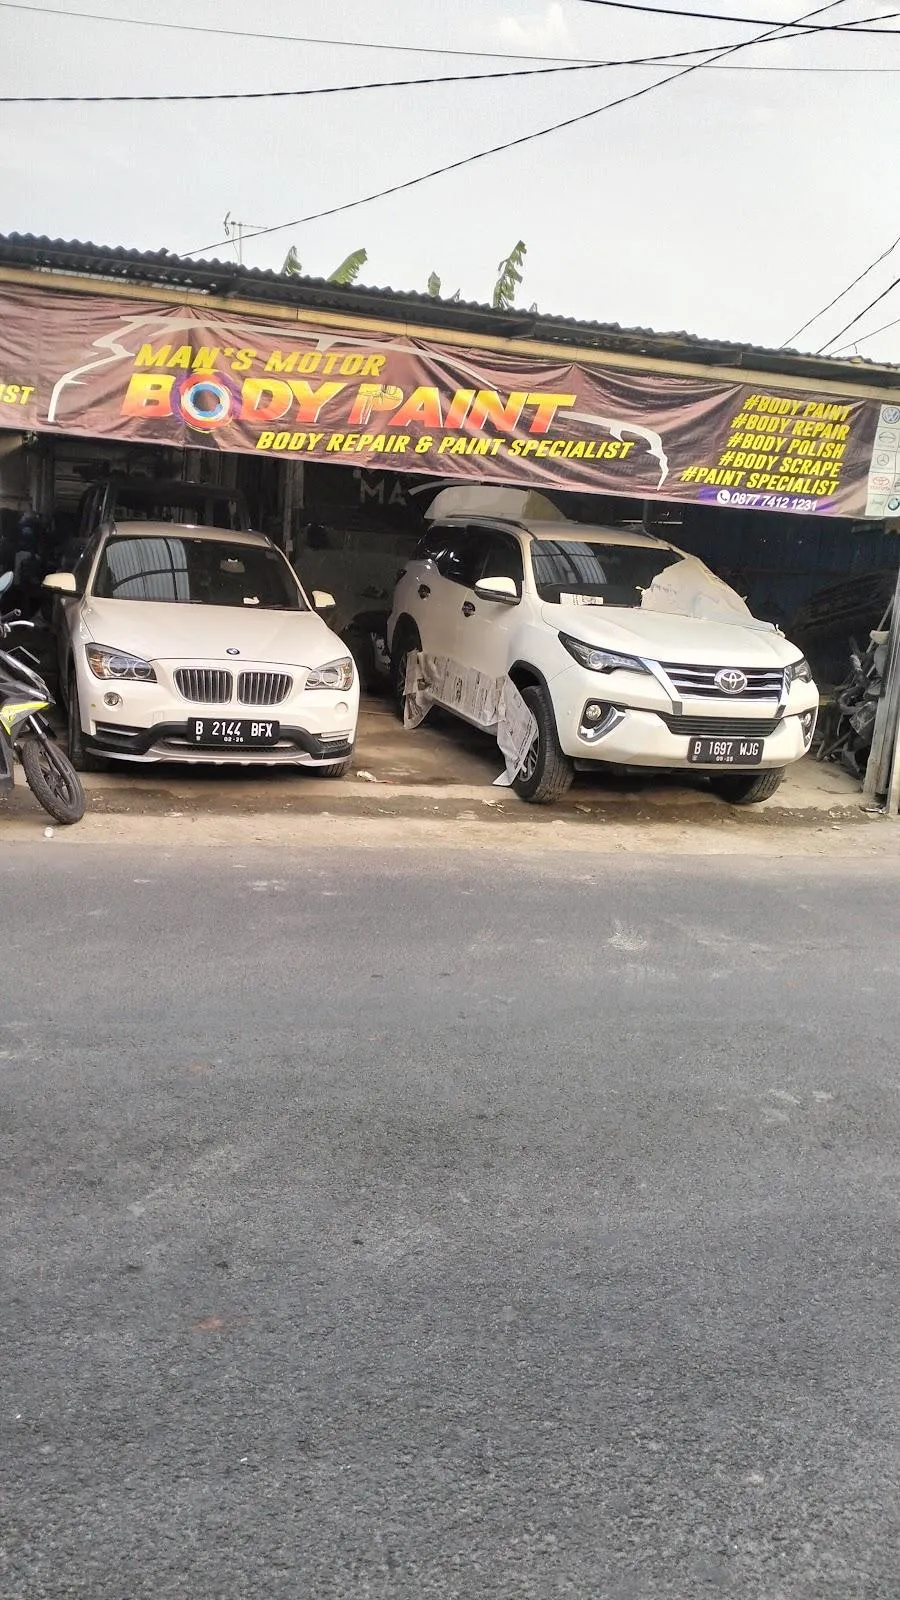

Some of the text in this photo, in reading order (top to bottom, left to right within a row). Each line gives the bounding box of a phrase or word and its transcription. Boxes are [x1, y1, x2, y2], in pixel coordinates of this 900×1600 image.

[134, 343, 386, 377] MAN'S MOTOR
[120, 369, 578, 433] BODY PAINT
[742, 394, 853, 421] #BODY PAINT
[730, 412, 850, 441] #BODY REPAIR
[255, 431, 635, 459] BODY REPAIR & PAINT SPECIALIST
[726, 431, 847, 459] #BODY POLISH
[718, 450, 844, 478] #BODY SCRAPE
[679, 466, 840, 496] #PAINT SPECIALIST
[731, 492, 818, 511] 0877 7412 1231
[195, 720, 273, 737] B 2144 BFX
[694, 741, 759, 756] B 1697 WJG
